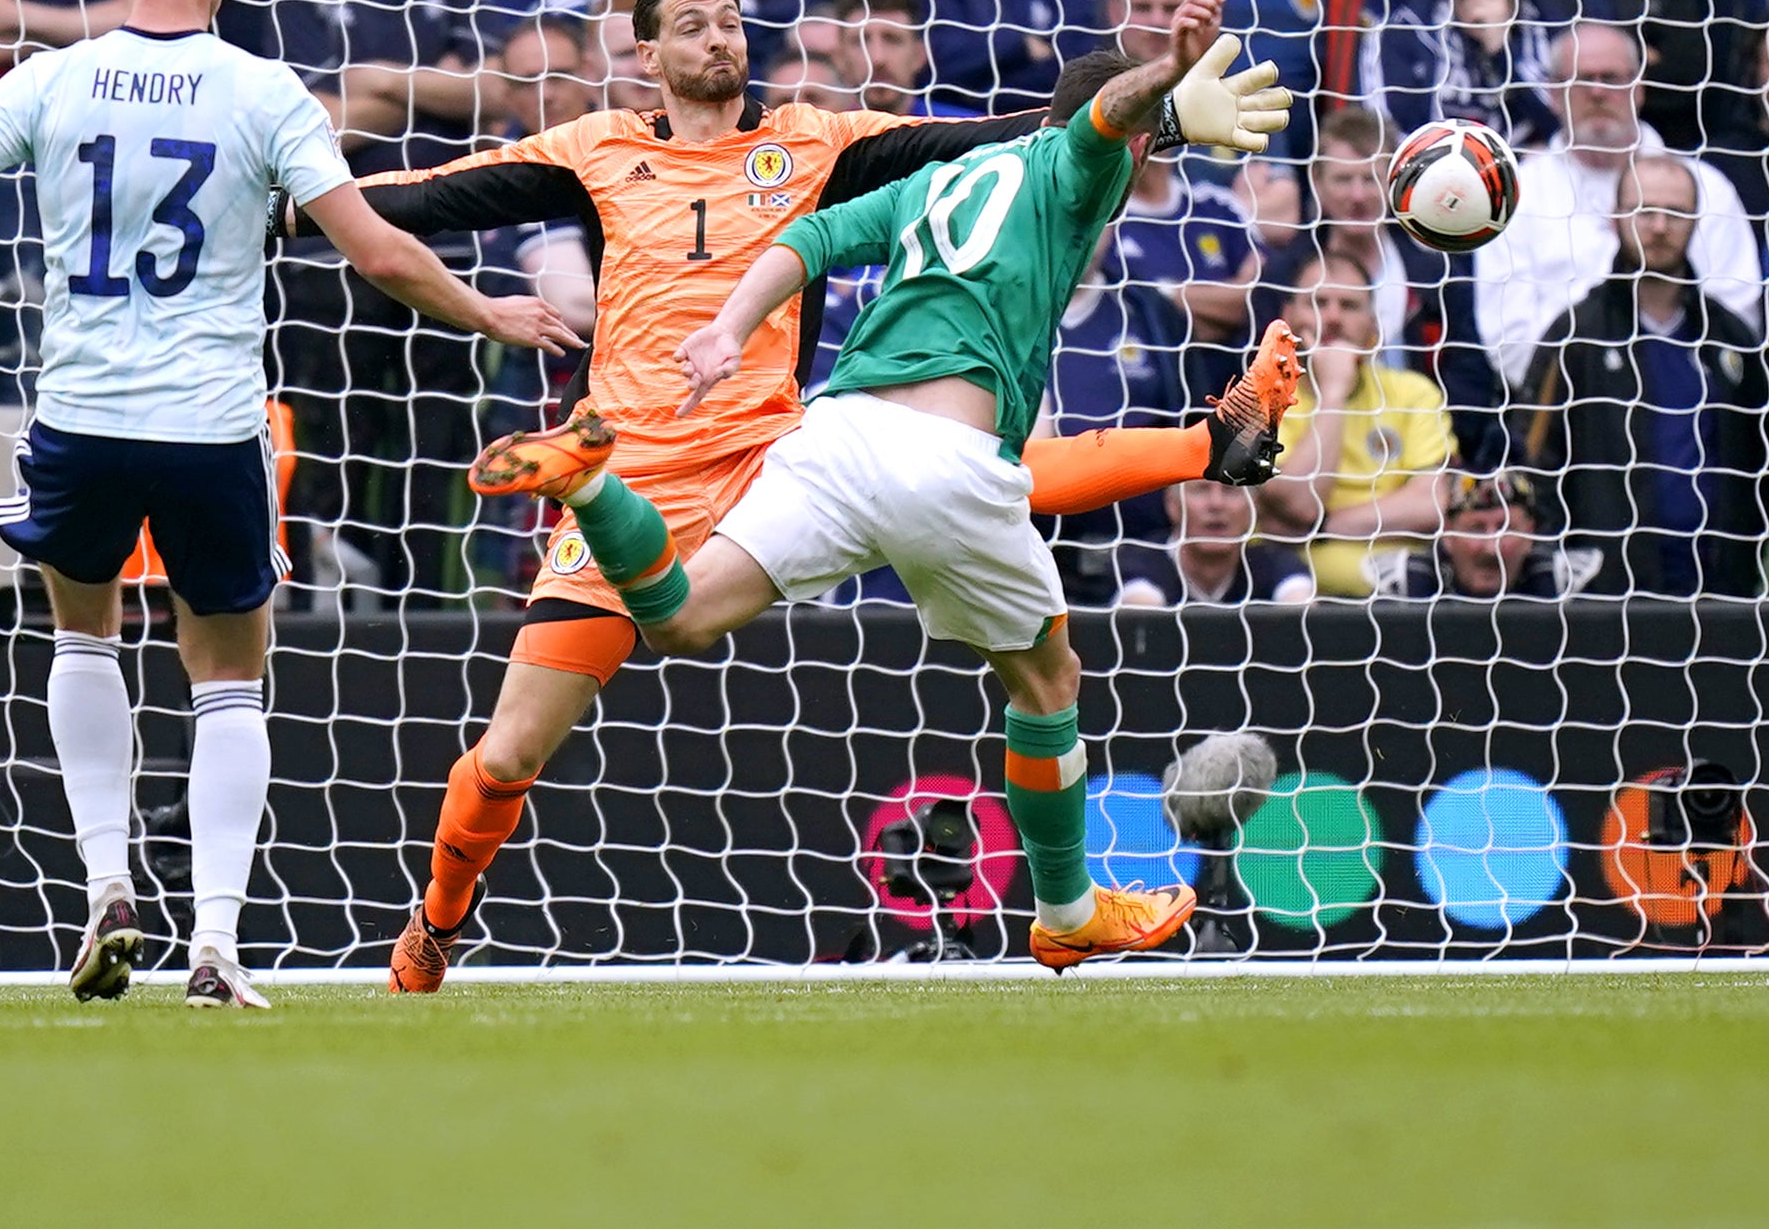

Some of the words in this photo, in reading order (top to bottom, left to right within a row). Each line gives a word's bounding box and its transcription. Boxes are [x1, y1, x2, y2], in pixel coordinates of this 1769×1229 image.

[92, 67, 203, 105] HENDRY
[68, 134, 217, 298] 13
[687, 198, 713, 261] 1
[900, 153, 1025, 280] 10
